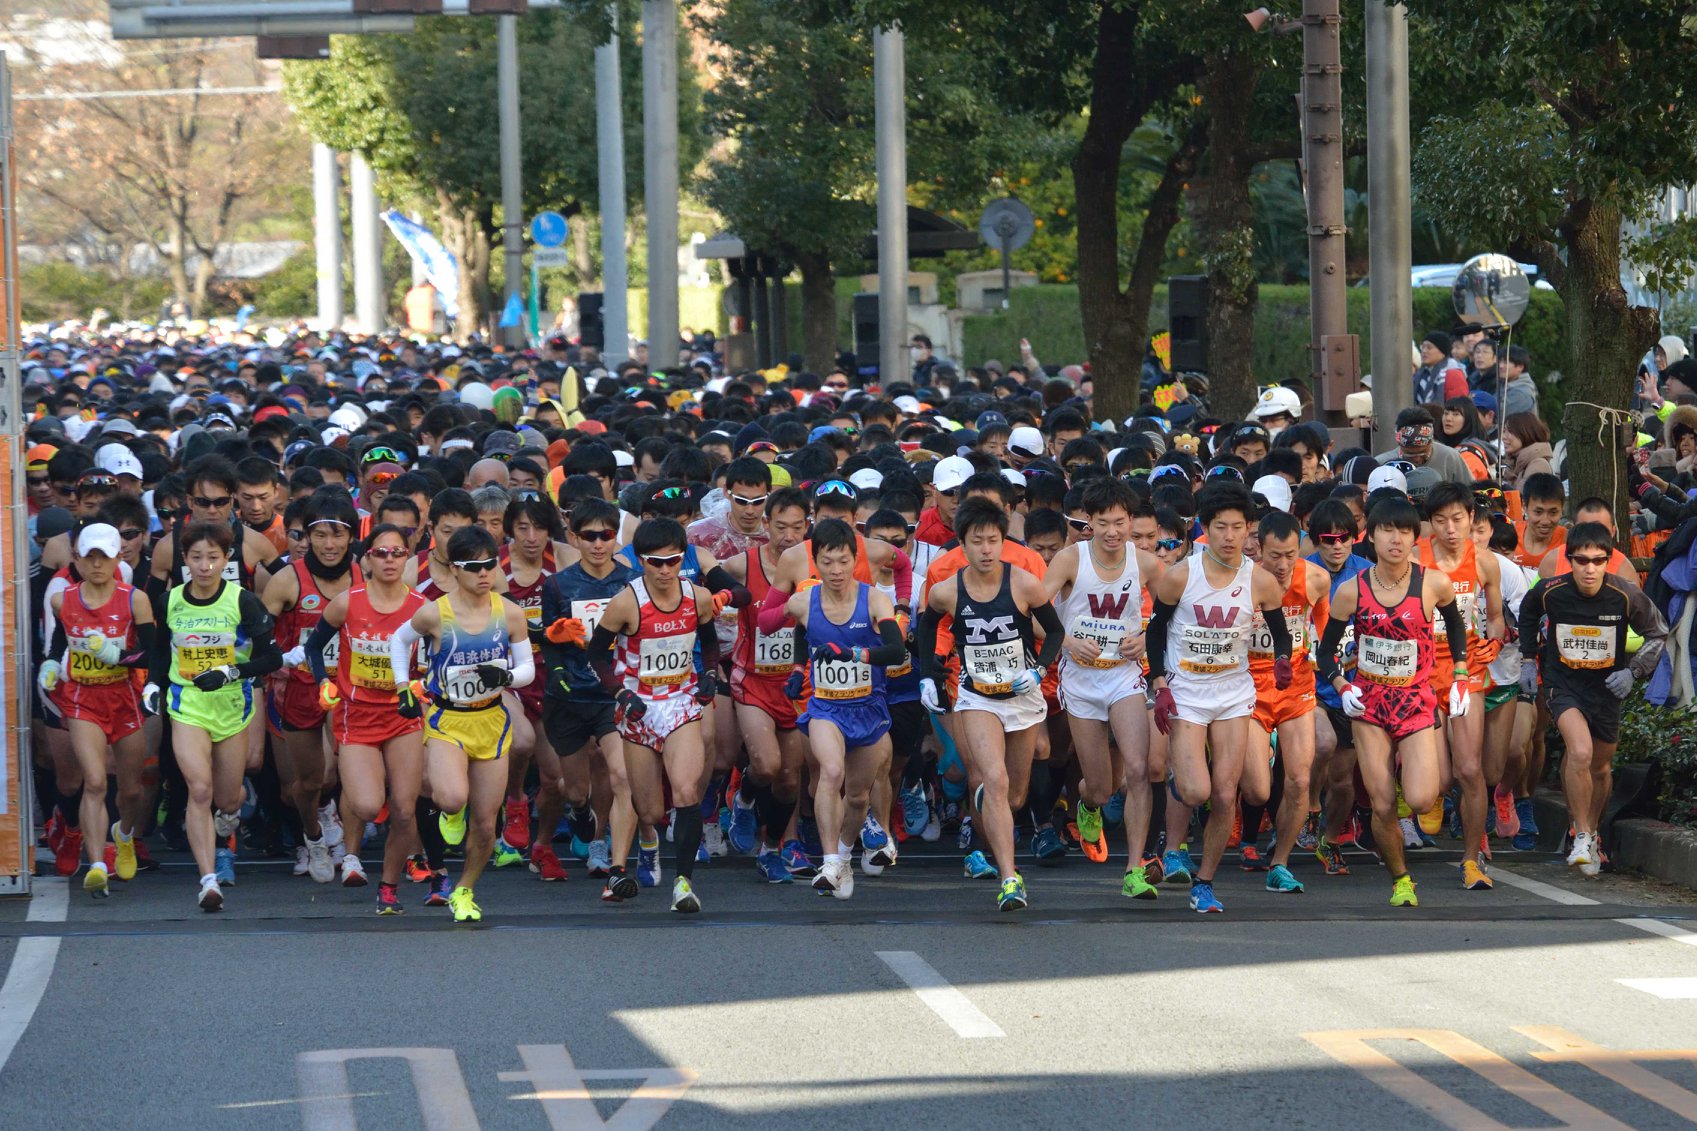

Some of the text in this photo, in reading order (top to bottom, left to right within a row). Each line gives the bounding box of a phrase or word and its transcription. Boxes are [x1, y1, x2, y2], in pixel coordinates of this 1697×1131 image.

[1087, 593, 1129, 620] W
[1193, 604, 1240, 629] W
[965, 615, 1019, 643] M
[202, 635, 221, 645] フジ
[974, 646, 1014, 658] BEMAC
[1582, 651, 1589, 660] 2
[644, 650, 688, 671] 1002
[1206, 656, 1214, 664] 6
[371, 669, 387, 679] 51
[1383, 667, 1390, 676] 5
[995, 672, 1003, 683] 8
